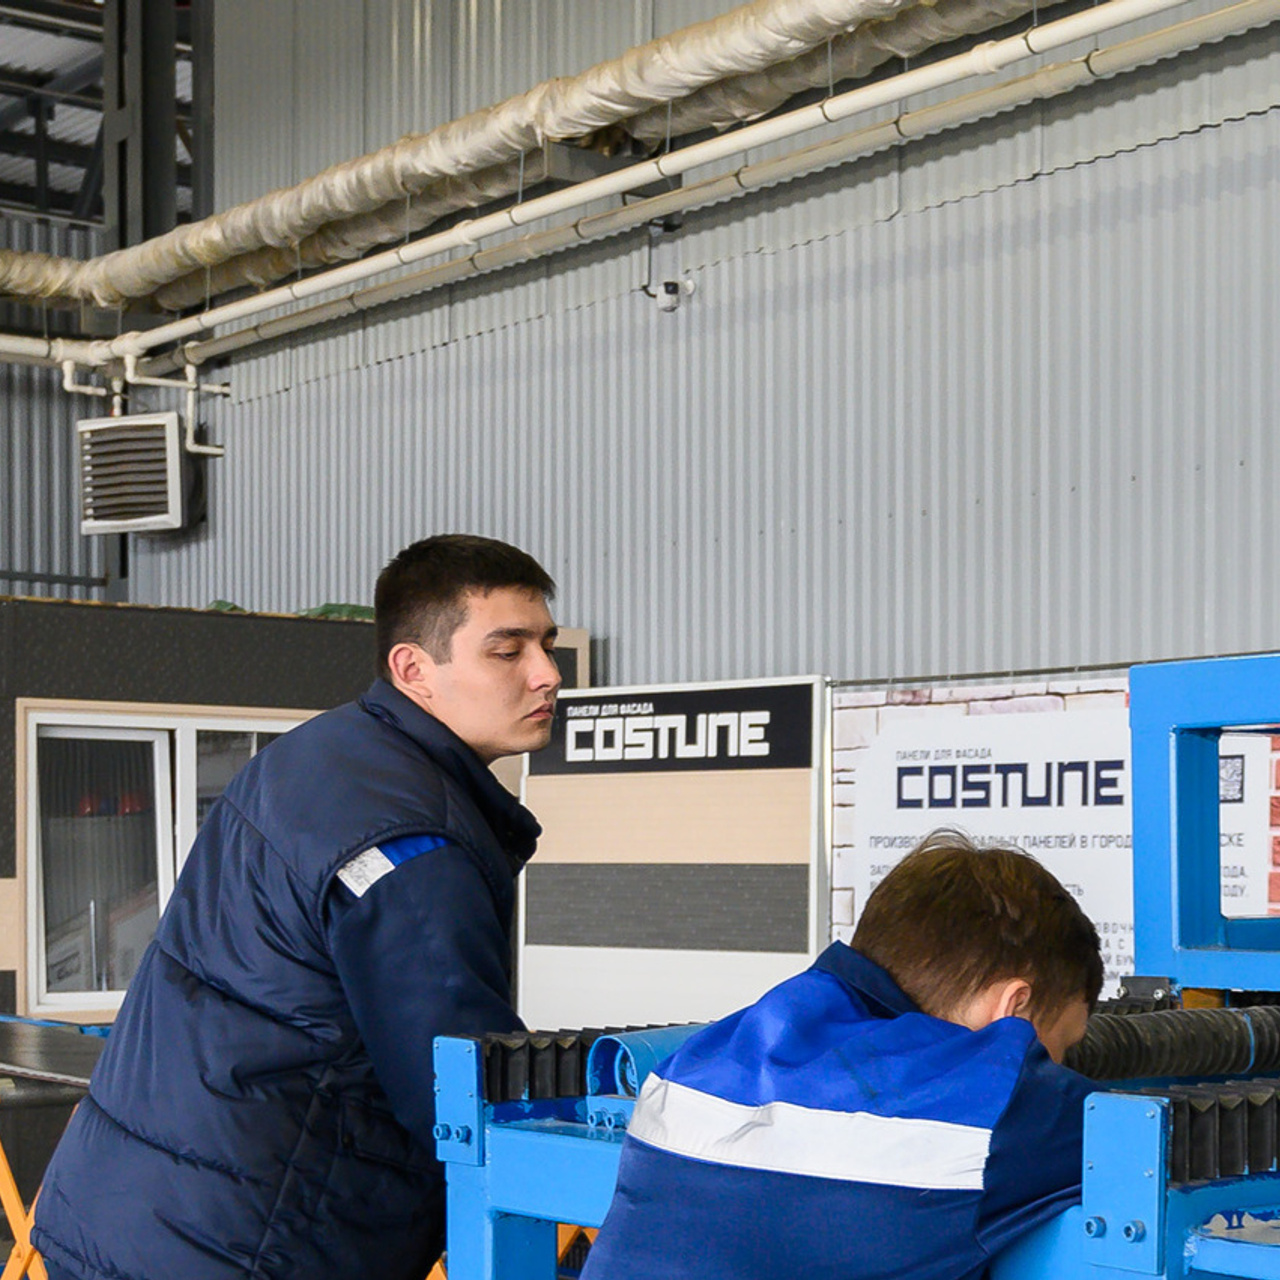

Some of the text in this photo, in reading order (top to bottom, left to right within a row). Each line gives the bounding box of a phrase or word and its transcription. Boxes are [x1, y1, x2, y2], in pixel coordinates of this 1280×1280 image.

[566, 702, 654, 717] ПАНЕЛИ ДЛЯ ФАСАДА
[566, 711, 770, 762] COSTUNE
[896, 748, 993, 761] ПАНЕЛИ ДЛЯ ФАСАДА
[896, 759, 1125, 809] COSTUNE
[1023, 832, 1077, 849] ПАНЕЛЕЙ
[1080, 835, 1089, 849] В
